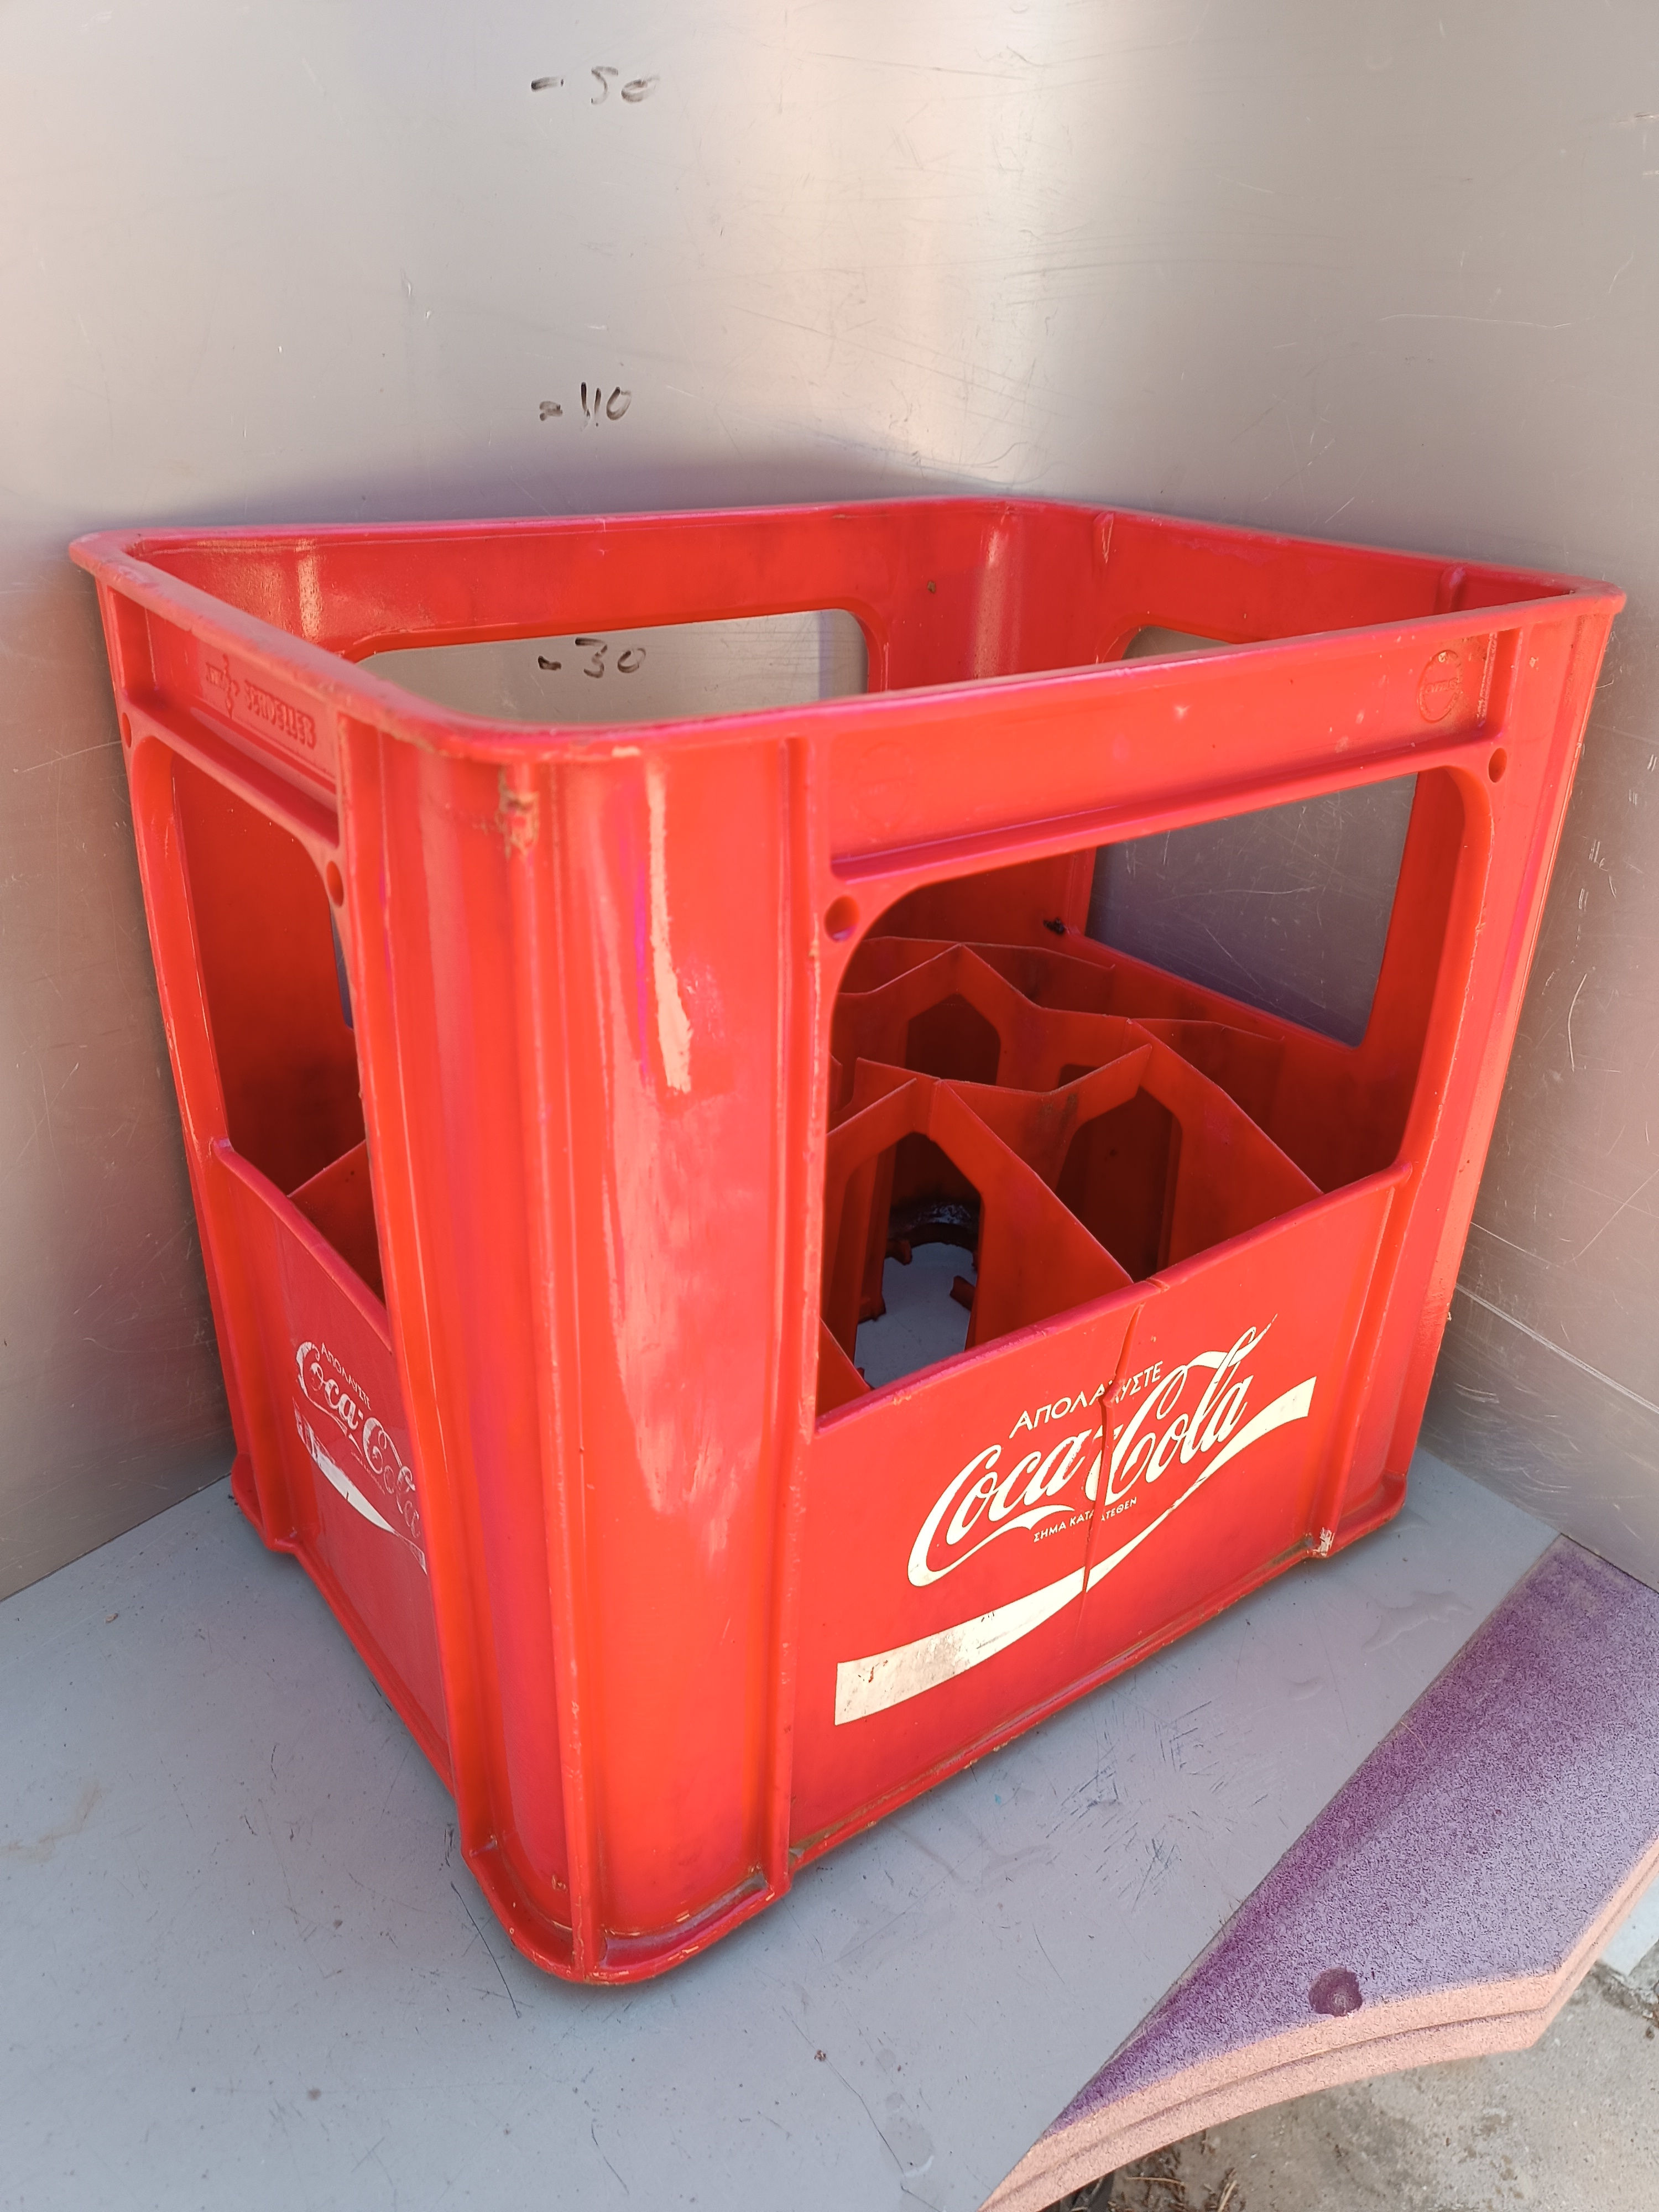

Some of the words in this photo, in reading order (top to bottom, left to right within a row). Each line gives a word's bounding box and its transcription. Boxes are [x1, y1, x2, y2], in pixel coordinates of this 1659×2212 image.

[591, 65, 660, 105] 50
[575, 637, 646, 679] 30
[1034, 1521, 1067, 1543] ΣΗΜΑ
